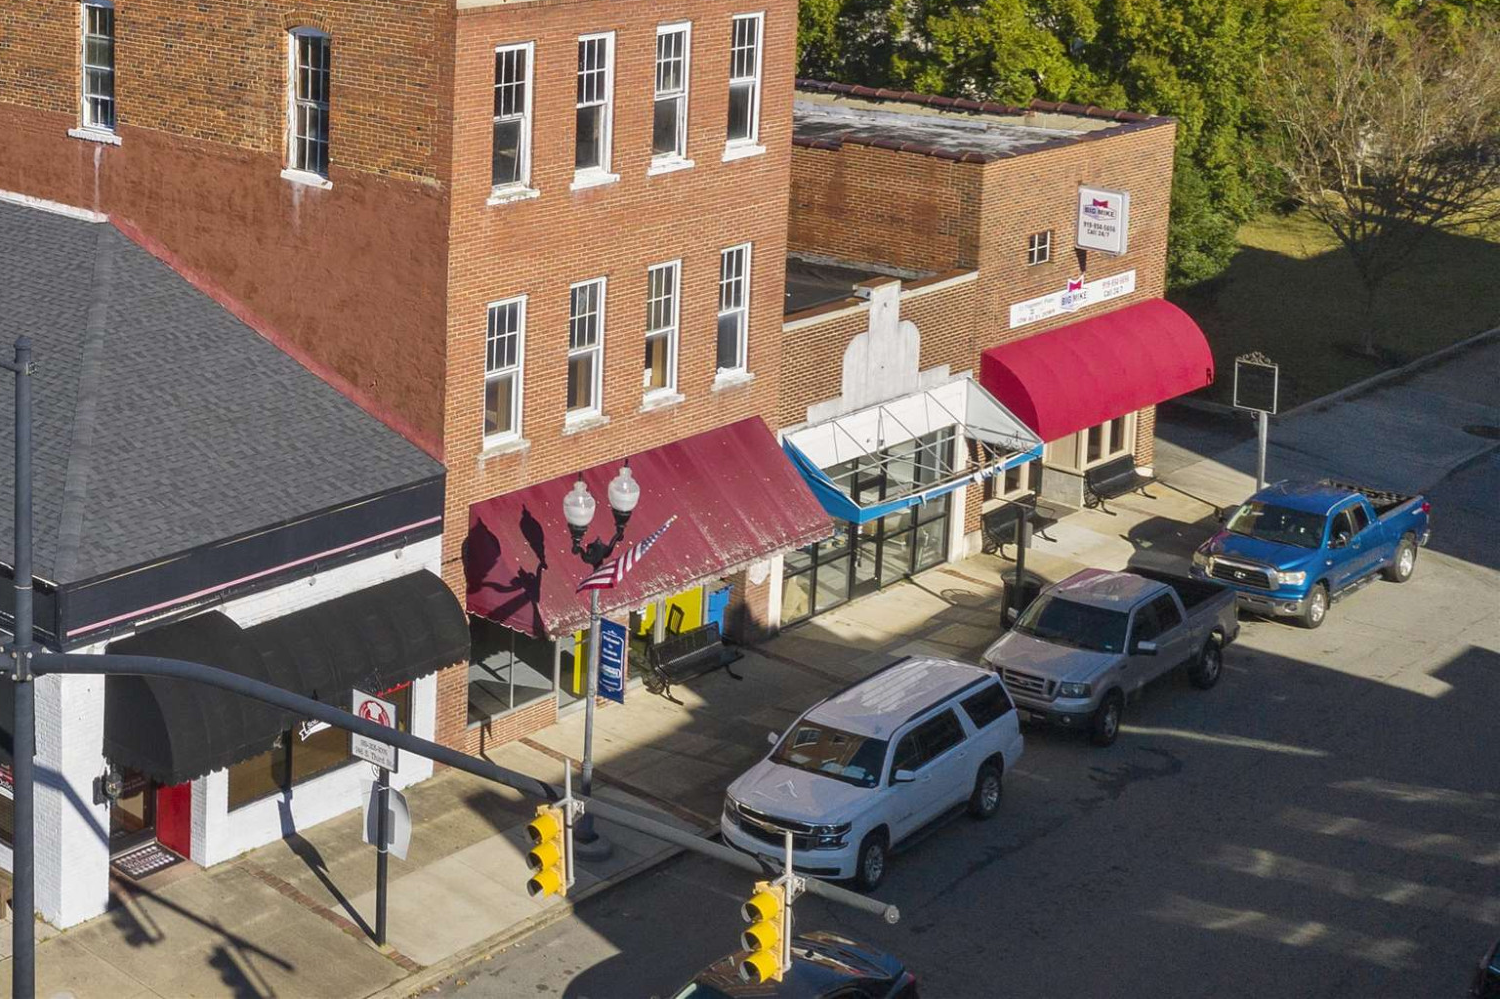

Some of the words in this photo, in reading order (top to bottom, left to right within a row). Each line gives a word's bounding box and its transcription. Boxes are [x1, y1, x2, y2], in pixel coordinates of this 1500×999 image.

[1084, 206, 1097, 214] BIG
[1098, 209, 1115, 218] MIKE
[1061, 295, 1072, 306] BIG
[1073, 290, 1087, 301] MIKE
